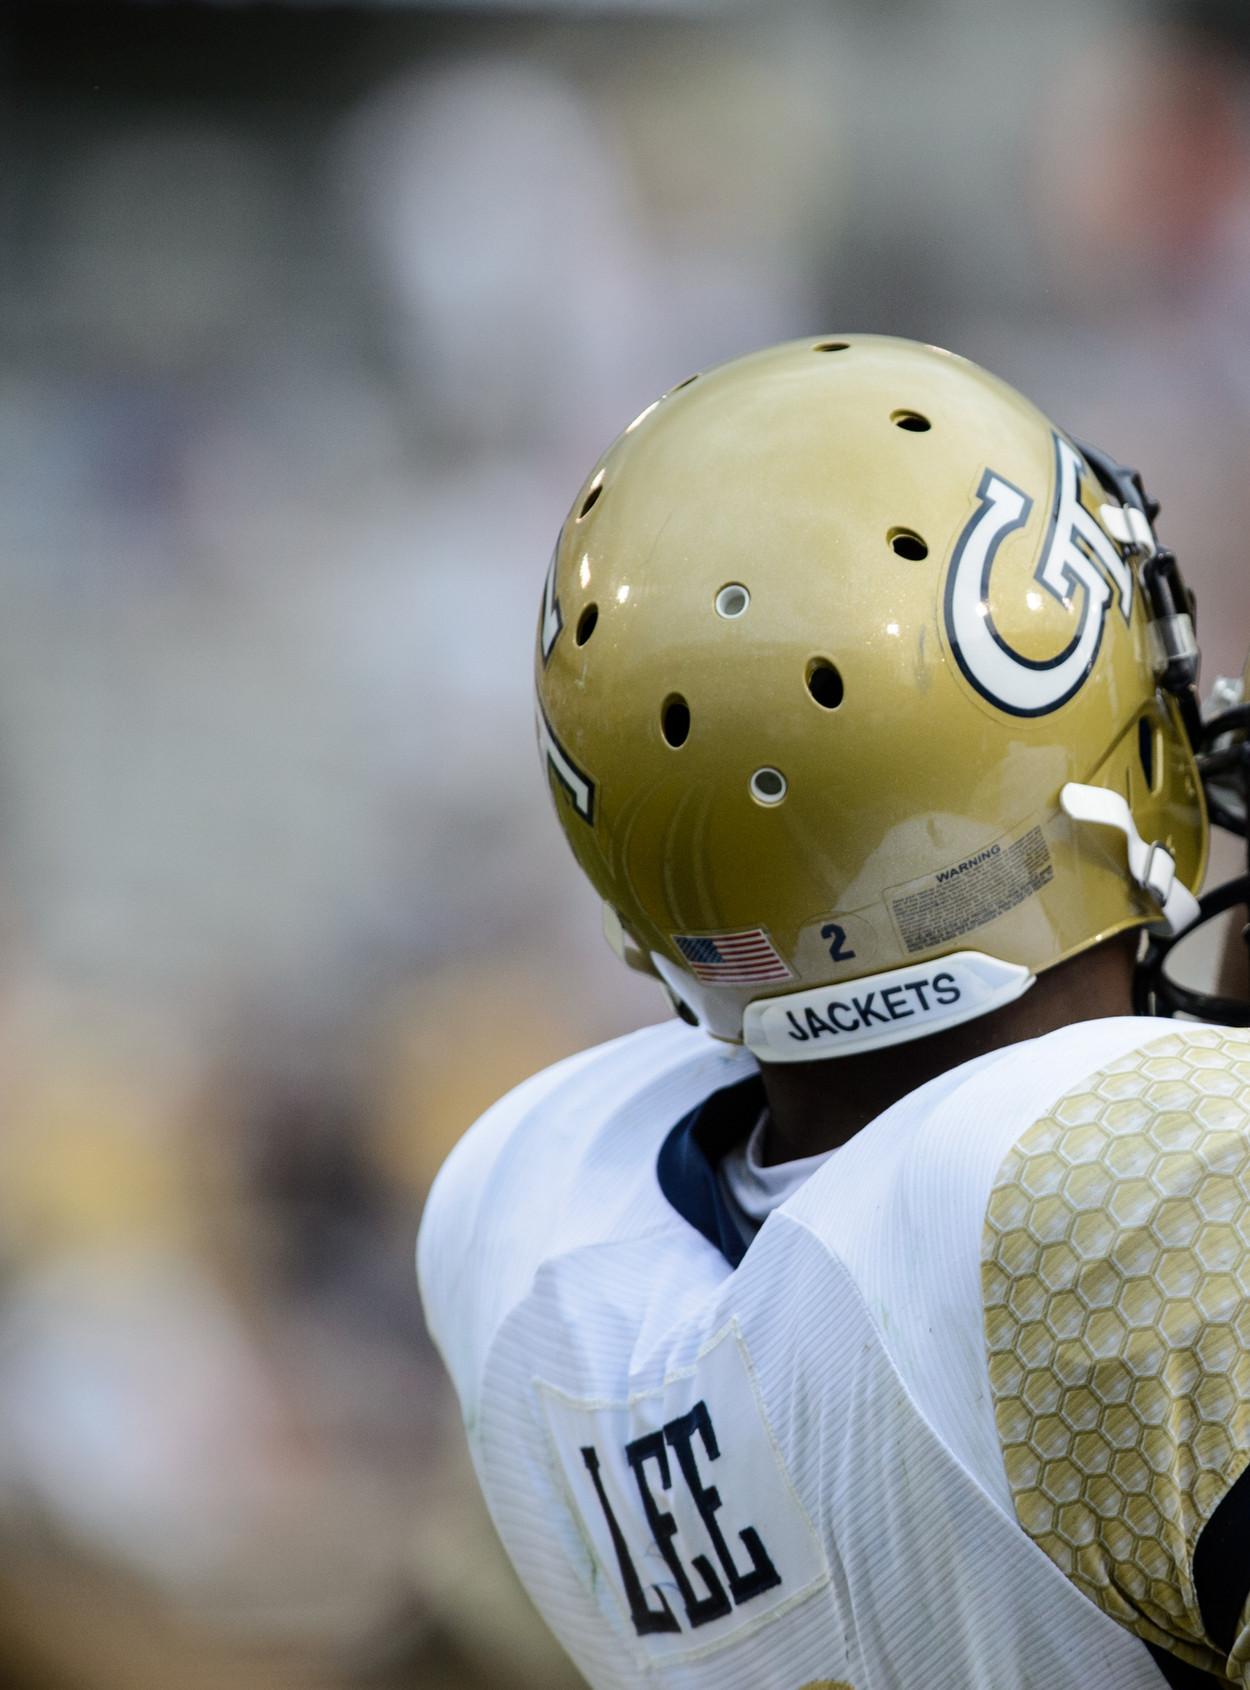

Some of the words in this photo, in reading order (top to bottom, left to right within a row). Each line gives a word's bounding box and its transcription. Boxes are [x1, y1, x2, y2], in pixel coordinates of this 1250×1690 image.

[935, 844, 1001, 884] WARNING
[820, 923, 857, 963] 2
[785, 972, 962, 1042] JACKETS
[580, 1400, 782, 1637] LEE
